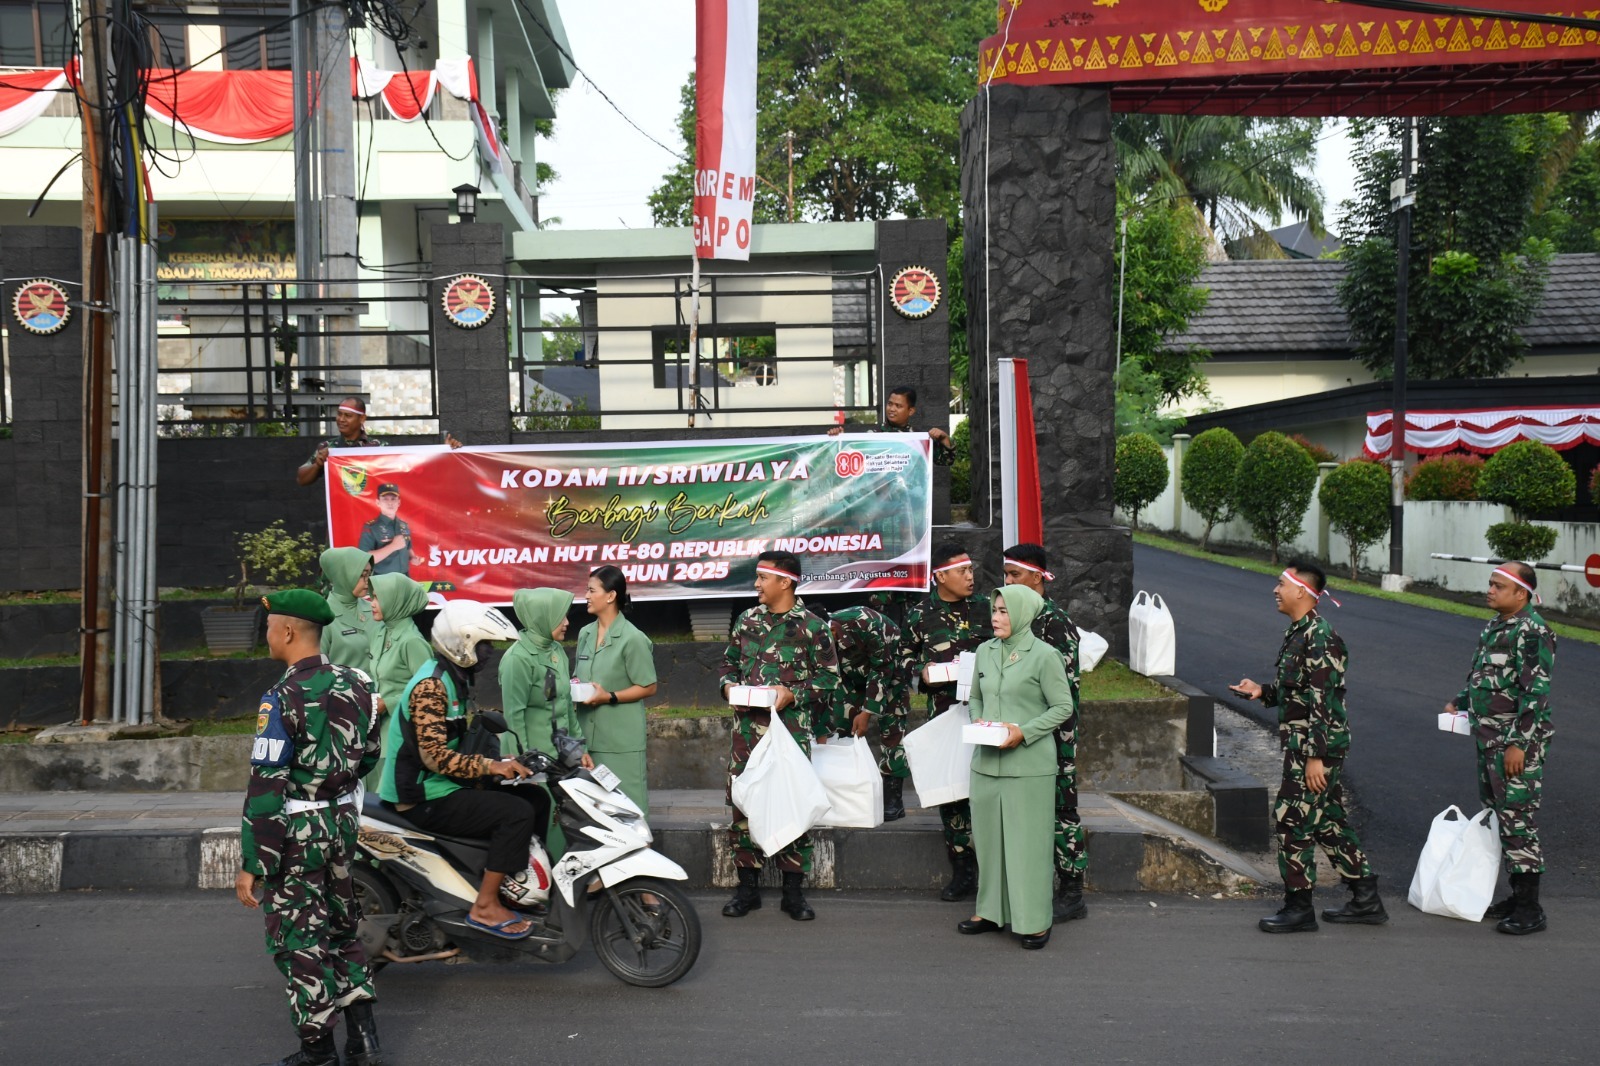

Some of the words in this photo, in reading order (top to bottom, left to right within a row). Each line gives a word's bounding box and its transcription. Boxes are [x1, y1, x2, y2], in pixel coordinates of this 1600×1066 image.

[694, 169, 754, 202] KOREM
[693, 215, 750, 249] GAPO
[264, 252, 281, 263] TNI
[500, 467, 609, 489] KODAM
[617, 459, 809, 486] II/SRIWIJAYA
[836, 452, 864, 477] 80
[547, 494, 659, 543] Berbagi
[665, 490, 769, 534] Berkah
[428, 546, 549, 567] SYUKURAN
[553, 545, 598, 562] HUT
[601, 543, 665, 561] KE-80
[669, 539, 769, 558] REPUBLIK
[774, 534, 882, 552] INDONESIA
[589, 563, 669, 582] HUN
[673, 561, 730, 580] 2025
[801, 573, 847, 582] Palembang,
[849, 572, 858, 580] 17
[859, 571, 891, 580] Agustus
[893, 570, 908, 578] 2025
[251, 737, 285, 761] OV
[603, 834, 627, 845] HONDA
